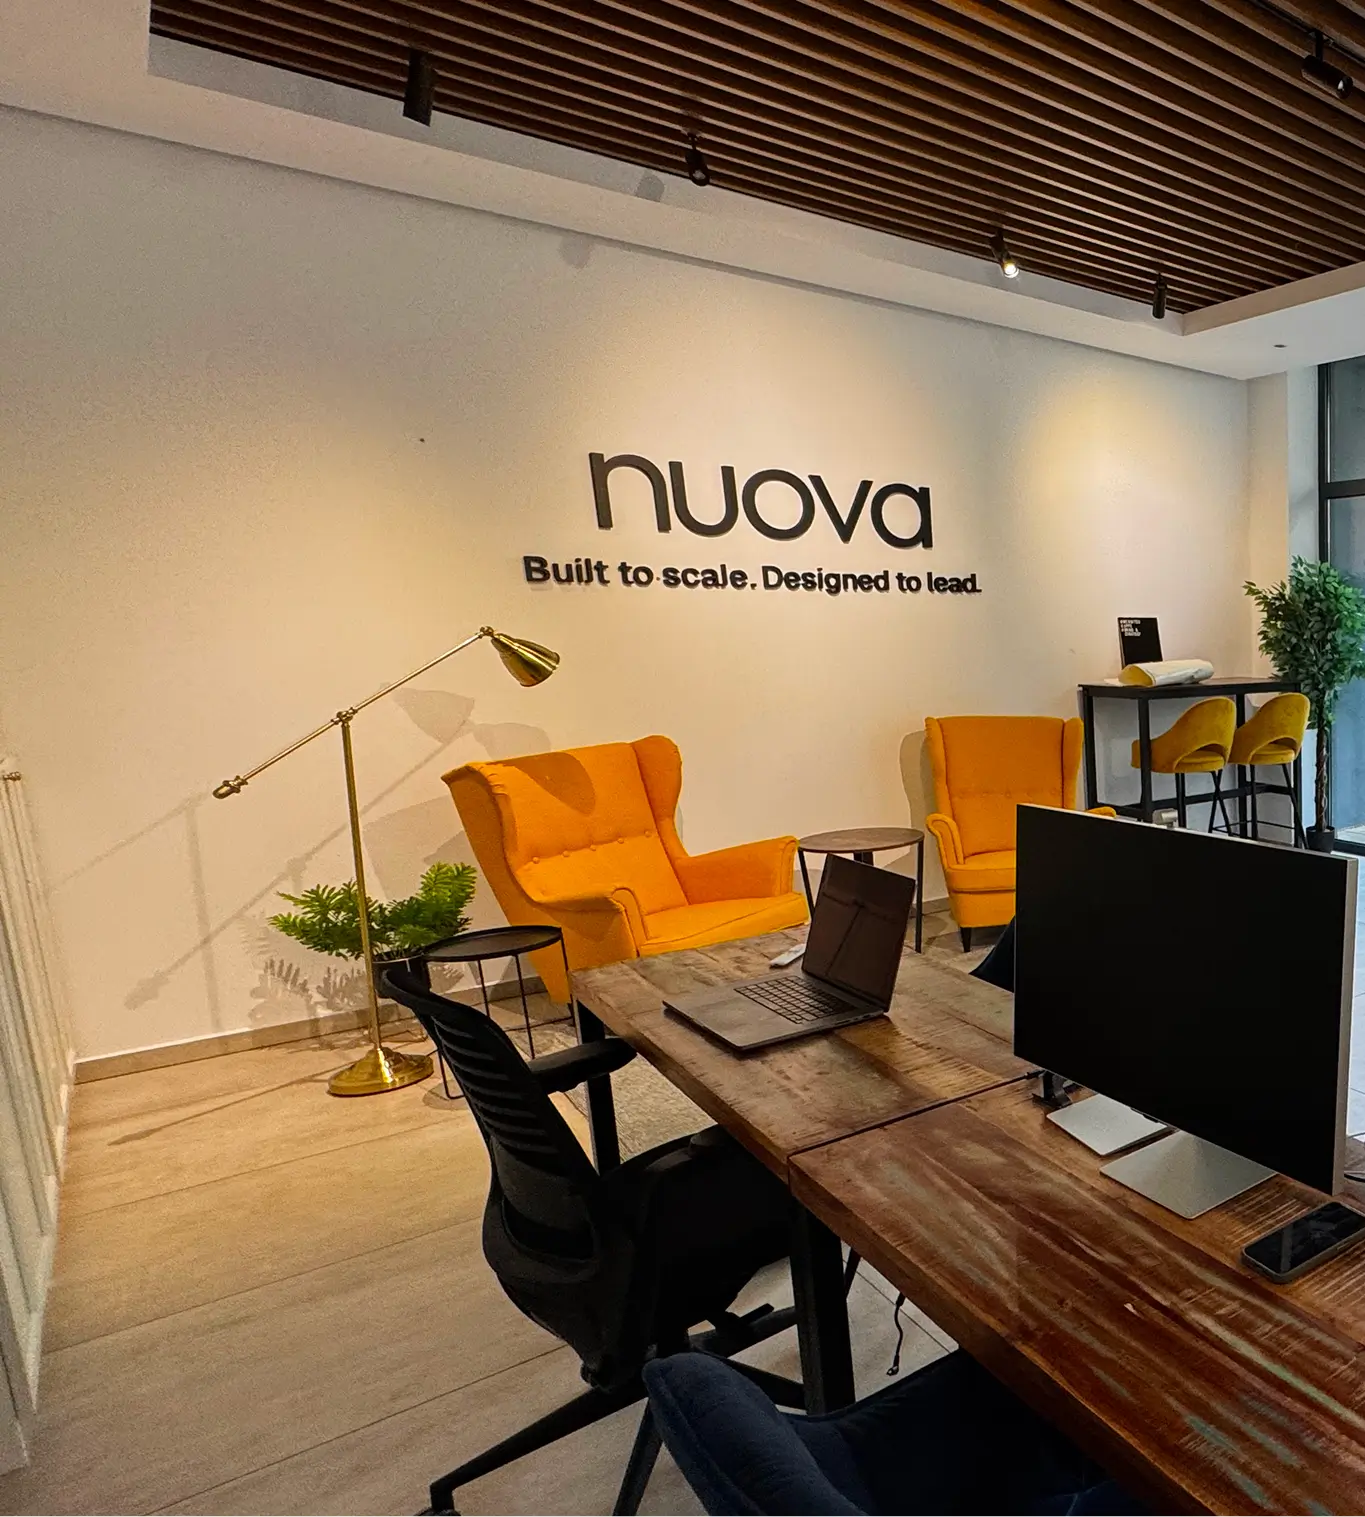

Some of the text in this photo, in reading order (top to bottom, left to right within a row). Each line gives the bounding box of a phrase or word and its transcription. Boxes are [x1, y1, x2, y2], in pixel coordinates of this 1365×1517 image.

[588, 452, 933, 549] nuova
[523, 555, 983, 596] Built to scale. Designed to lead.
